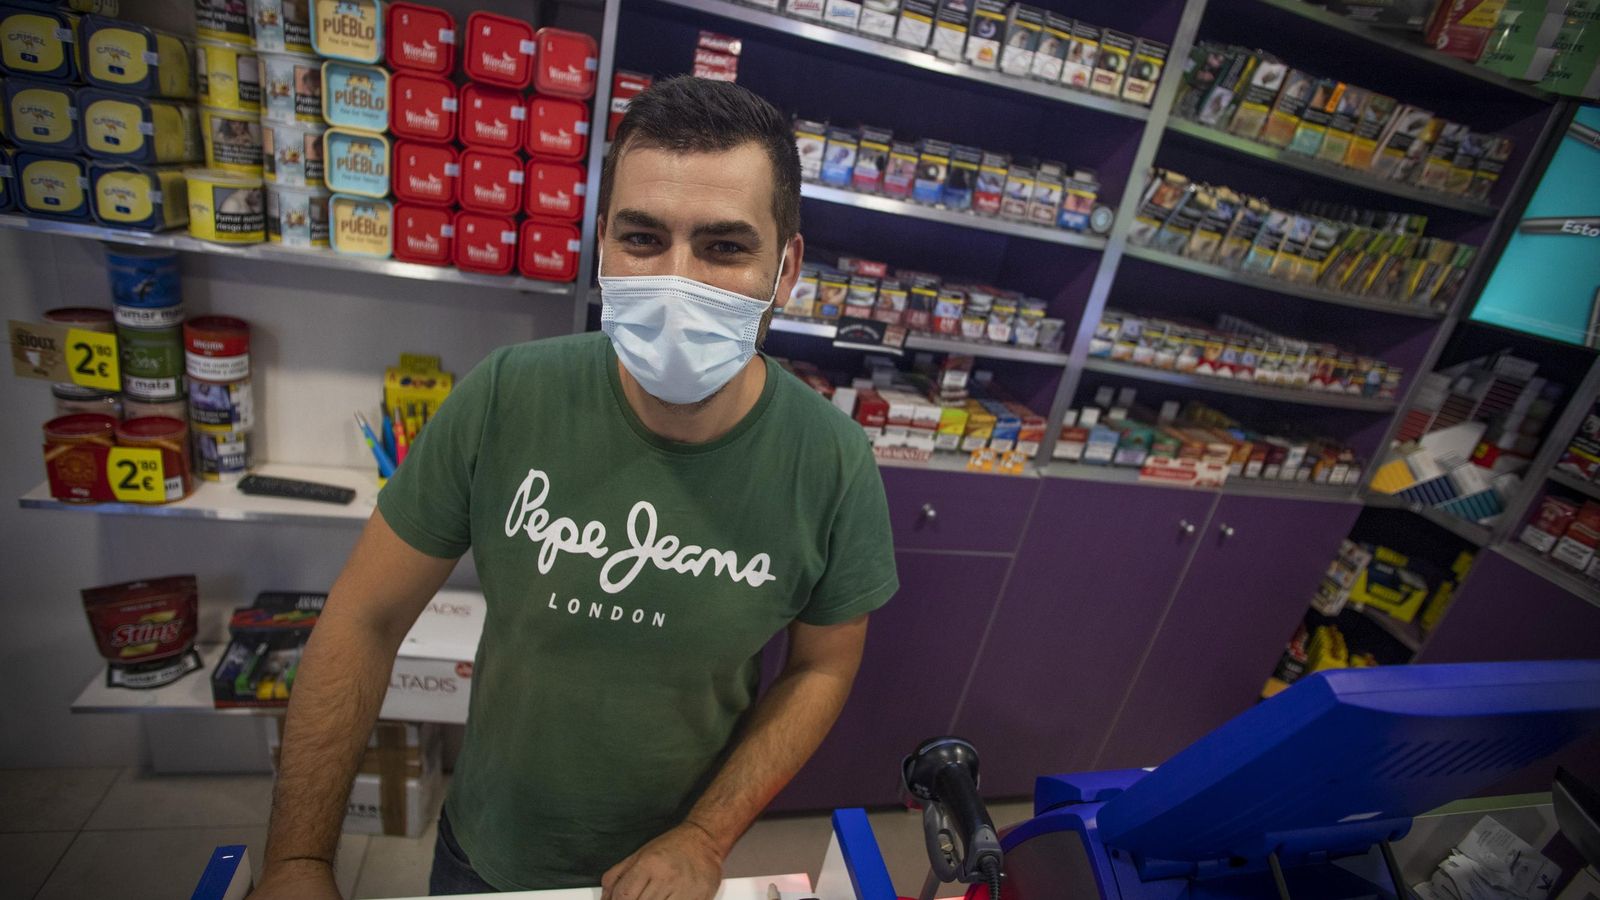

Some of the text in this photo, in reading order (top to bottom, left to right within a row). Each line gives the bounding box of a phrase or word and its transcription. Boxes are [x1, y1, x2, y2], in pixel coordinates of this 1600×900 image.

[323, 14, 374, 40] PUEBLO
[8, 33, 47, 47] CAMEL
[96, 46, 132, 60] CAMEL
[403, 42, 437, 59] Winston
[482, 52, 516, 70] Winston
[549, 66, 581, 82] Winston
[335, 86, 384, 111] PUEBLO
[19, 106, 55, 120] CAMEL
[406, 110, 439, 127] Winston
[92, 117, 128, 130] CAMEL
[475, 120, 508, 136] Winston
[540, 131, 571, 146] Winston
[335, 153, 384, 177] PUEBLO
[30, 177, 66, 189] CAMEL
[409, 175, 442, 191] Winston
[104, 188, 136, 200] CAMEL
[474, 185, 506, 200] Winston
[539, 192, 570, 207] Winston
[341, 215, 387, 237] PUEBLO
[1561, 219, 1599, 237] Esto
[407, 236, 438, 251] Winston
[468, 245, 498, 261] Winston
[534, 253, 564, 267] Winston
[16, 332, 56, 350] SIOUX
[73, 342, 96, 375] 2
[135, 380, 169, 389] mata
[117, 460, 139, 490] 2
[505, 468, 776, 594] Pepe Jeans
[548, 592, 666, 628] LONDON
